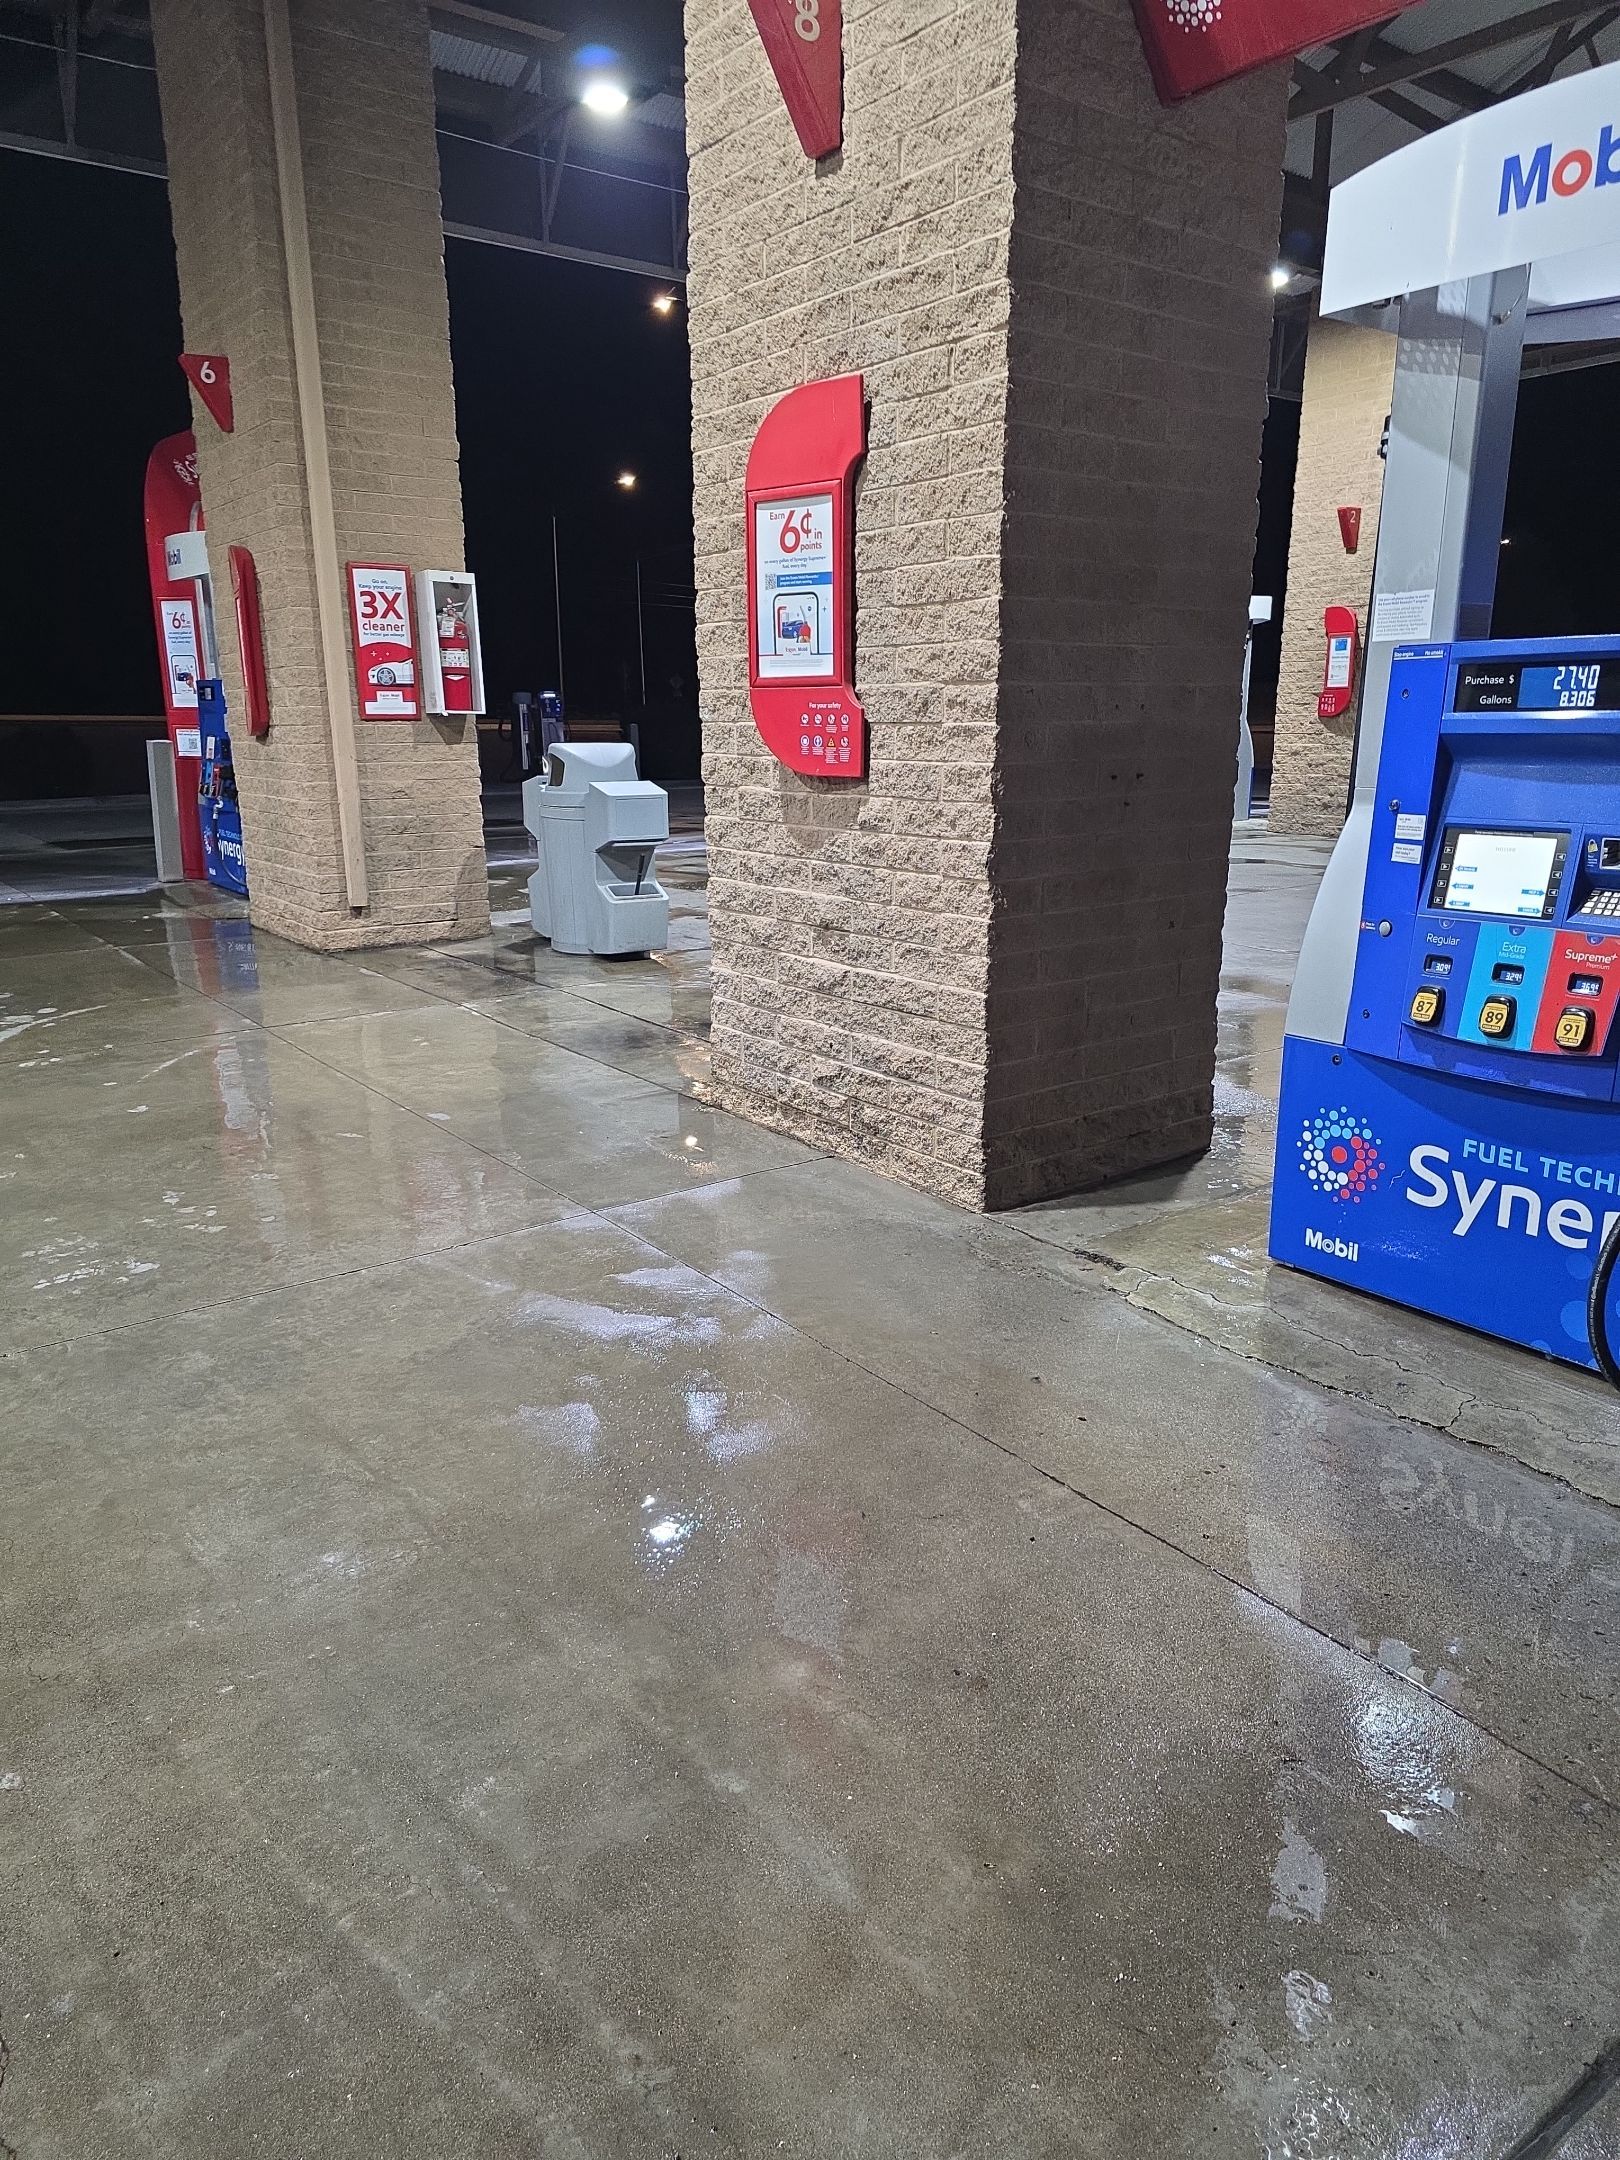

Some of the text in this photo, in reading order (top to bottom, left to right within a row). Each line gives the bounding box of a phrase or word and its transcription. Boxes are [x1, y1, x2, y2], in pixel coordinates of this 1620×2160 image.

[795, 0, 820, 42] 8
[201, 361, 216, 384] 6
[1350, 511, 1356, 523] 2
[769, 508, 822, 554] Earn 6¢ in
[801, 541, 822, 553] points
[360, 591, 404, 620] 3X
[362, 620, 405, 632] cleaner
[1465, 675, 1514, 685] Purchase $
[1479, 695, 1512, 704] Gallons
[217, 833, 246, 867] ynergy
[1426, 933, 1460, 946] Regular
[1502, 942, 1527, 954] Extra
[1586, 962, 1610, 970] Premium
[1416, 1000, 1434, 1013] 87
[1486, 1011, 1504, 1024] 89
[1563, 1023, 1579, 1037] 91
[1462, 1138, 1620, 1196] FUEL TECH
[1305, 1228, 1359, 1262] Mobil
